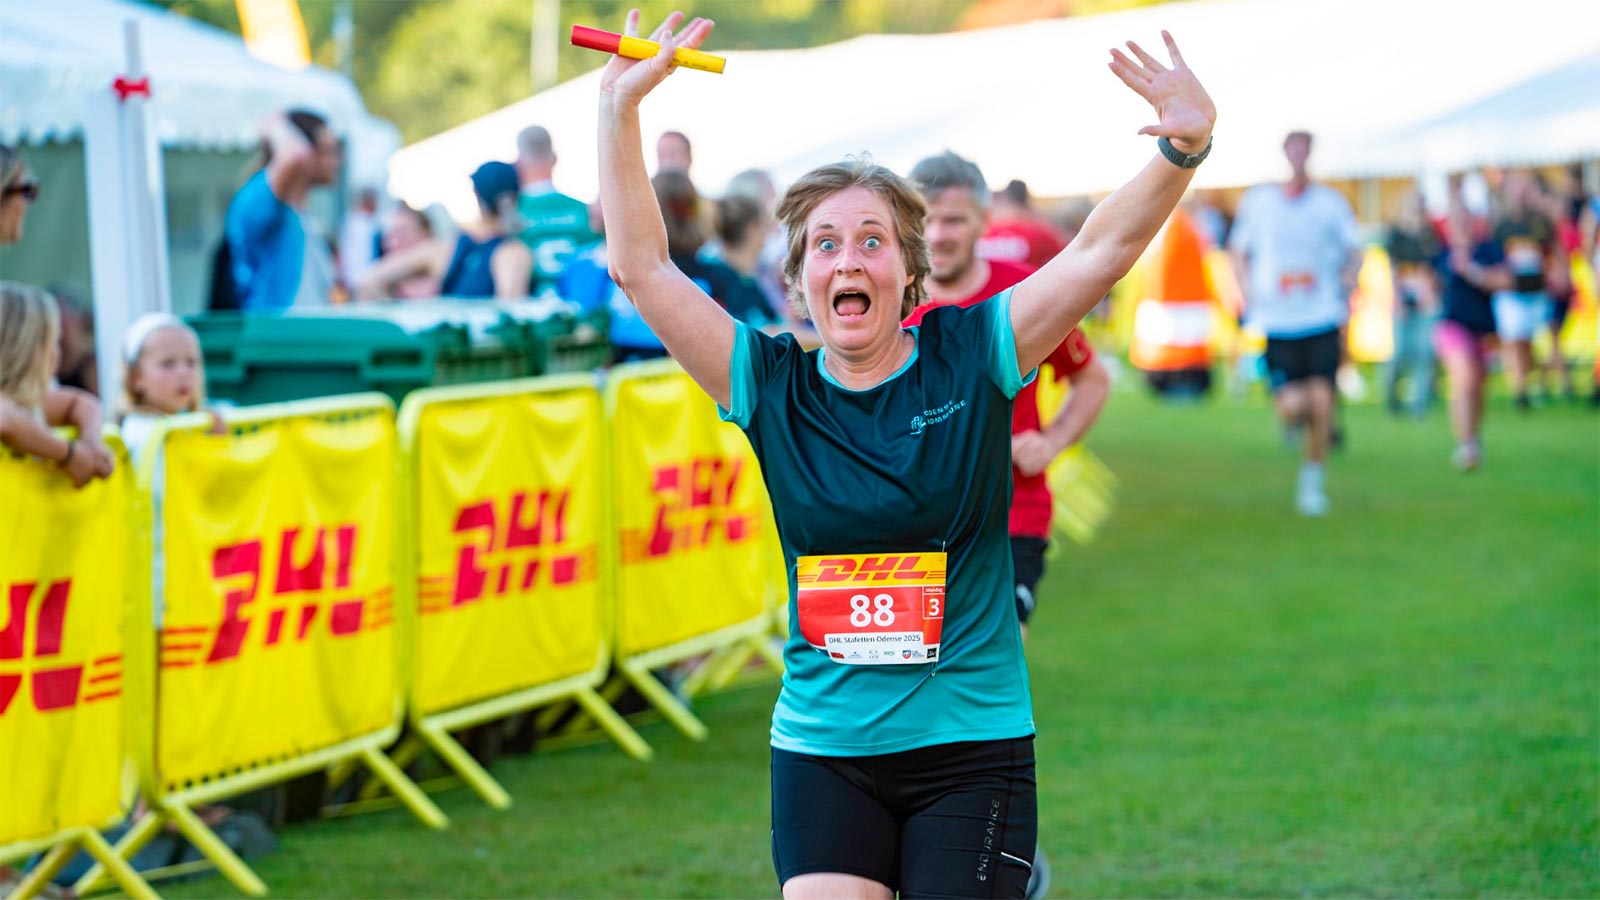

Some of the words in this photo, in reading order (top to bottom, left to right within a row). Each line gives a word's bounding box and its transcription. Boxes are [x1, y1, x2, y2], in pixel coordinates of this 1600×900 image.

[648, 457, 744, 557] DHL
[451, 490, 578, 608] DHL
[816, 556, 928, 582] DHL
[205, 524, 364, 665] DHL
[850, 593, 895, 628] 88
[928, 597, 940, 617] 3
[0, 577, 84, 715] HL
[903, 634, 921, 642] 2025
